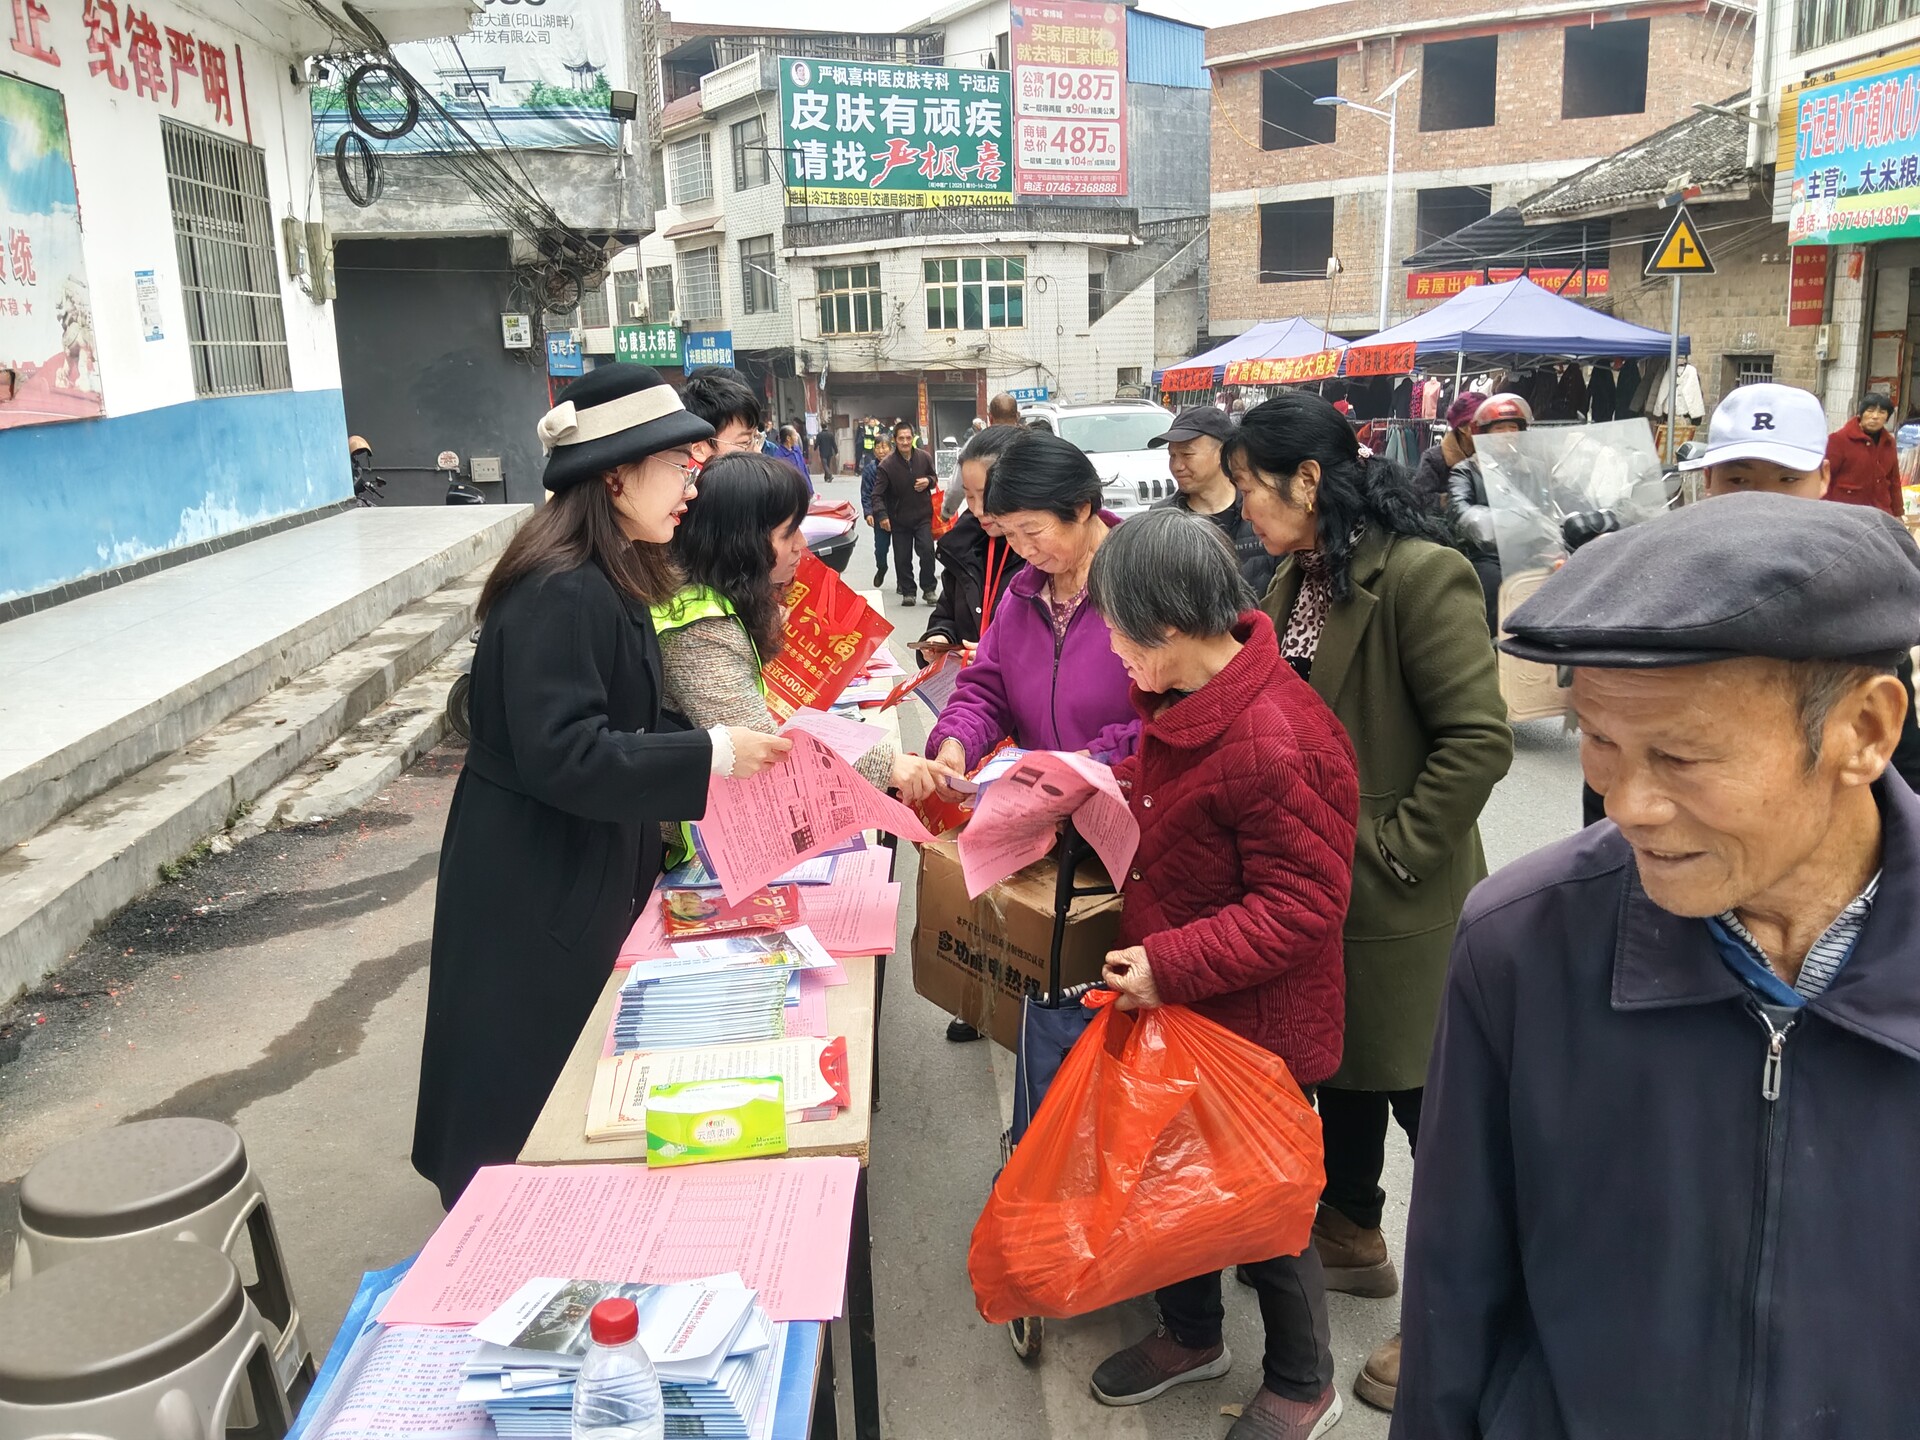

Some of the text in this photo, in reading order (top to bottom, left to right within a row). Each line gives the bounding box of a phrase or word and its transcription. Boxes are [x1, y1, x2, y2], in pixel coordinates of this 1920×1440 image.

[1031, 24, 1104, 45] 买家居建材
[82, 0, 233, 126] 纪律严明
[1017, 44, 1119, 67] 就去海汇家博城
[818, 65, 1000, 93] 严枫喜中医皮肤专科 宁远店
[1023, 71, 1044, 85] 公寓
[1046, 72, 1115, 100] 19.8万
[1023, 85, 1044, 98] 总价
[791, 90, 1002, 138] 皮肤有顽疾
[1023, 125, 1047, 139] 商铺
[1024, 139, 1047, 153] 总价
[943, 194, 1010, 207] 18973681116
[1416, 274, 1476, 295] 房屋出售
[629, 329, 676, 352] 康复大药房
[1229, 350, 1337, 382] 中高档服装清仓大甩卖
[1752, 412, 1775, 430] R
[798, 635, 822, 658] LIU
[820, 655, 843, 676] FU
